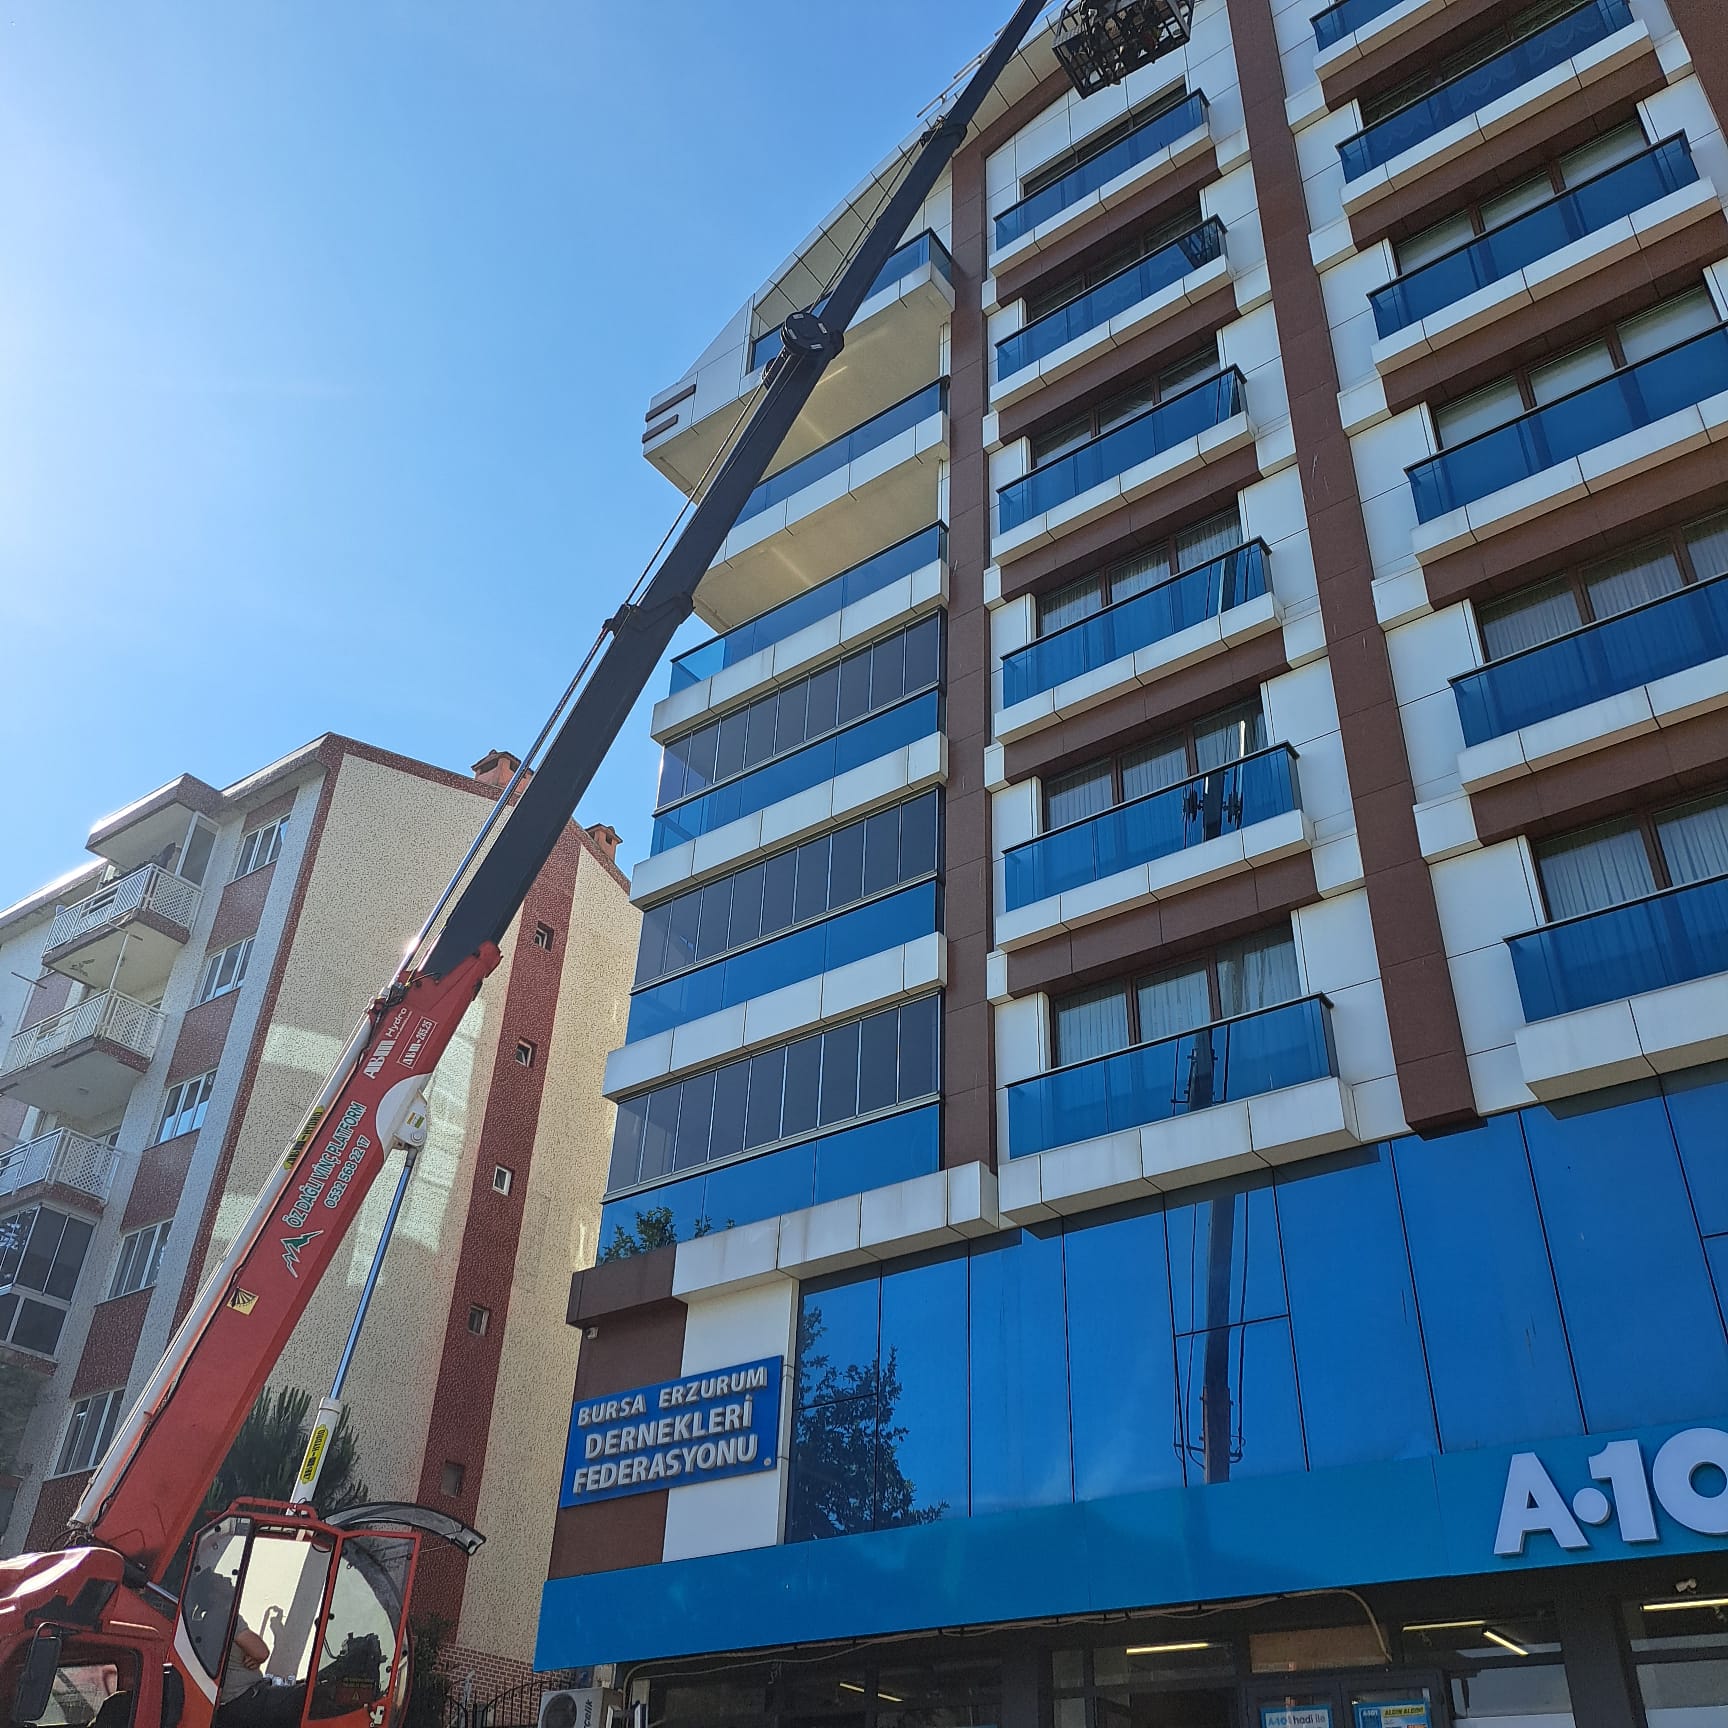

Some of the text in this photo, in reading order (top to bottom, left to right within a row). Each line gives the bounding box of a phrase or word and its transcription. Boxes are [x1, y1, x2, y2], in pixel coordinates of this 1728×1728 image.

[363, 1040, 396, 1079] ABM
[385, 1007, 407, 1038] Hydro
[325, 1101, 367, 1157] PLATFORM
[311, 1152, 341, 1180] VİNÇ
[324, 1134, 371, 1208] 0532 568 22 17
[282, 1207, 308, 1228] ÖZ
[577, 1366, 768, 1427] BURSA ERZURUM
[585, 1394, 753, 1460] DERNEKLERİ
[572, 1434, 759, 1495] FEDERASYONU
